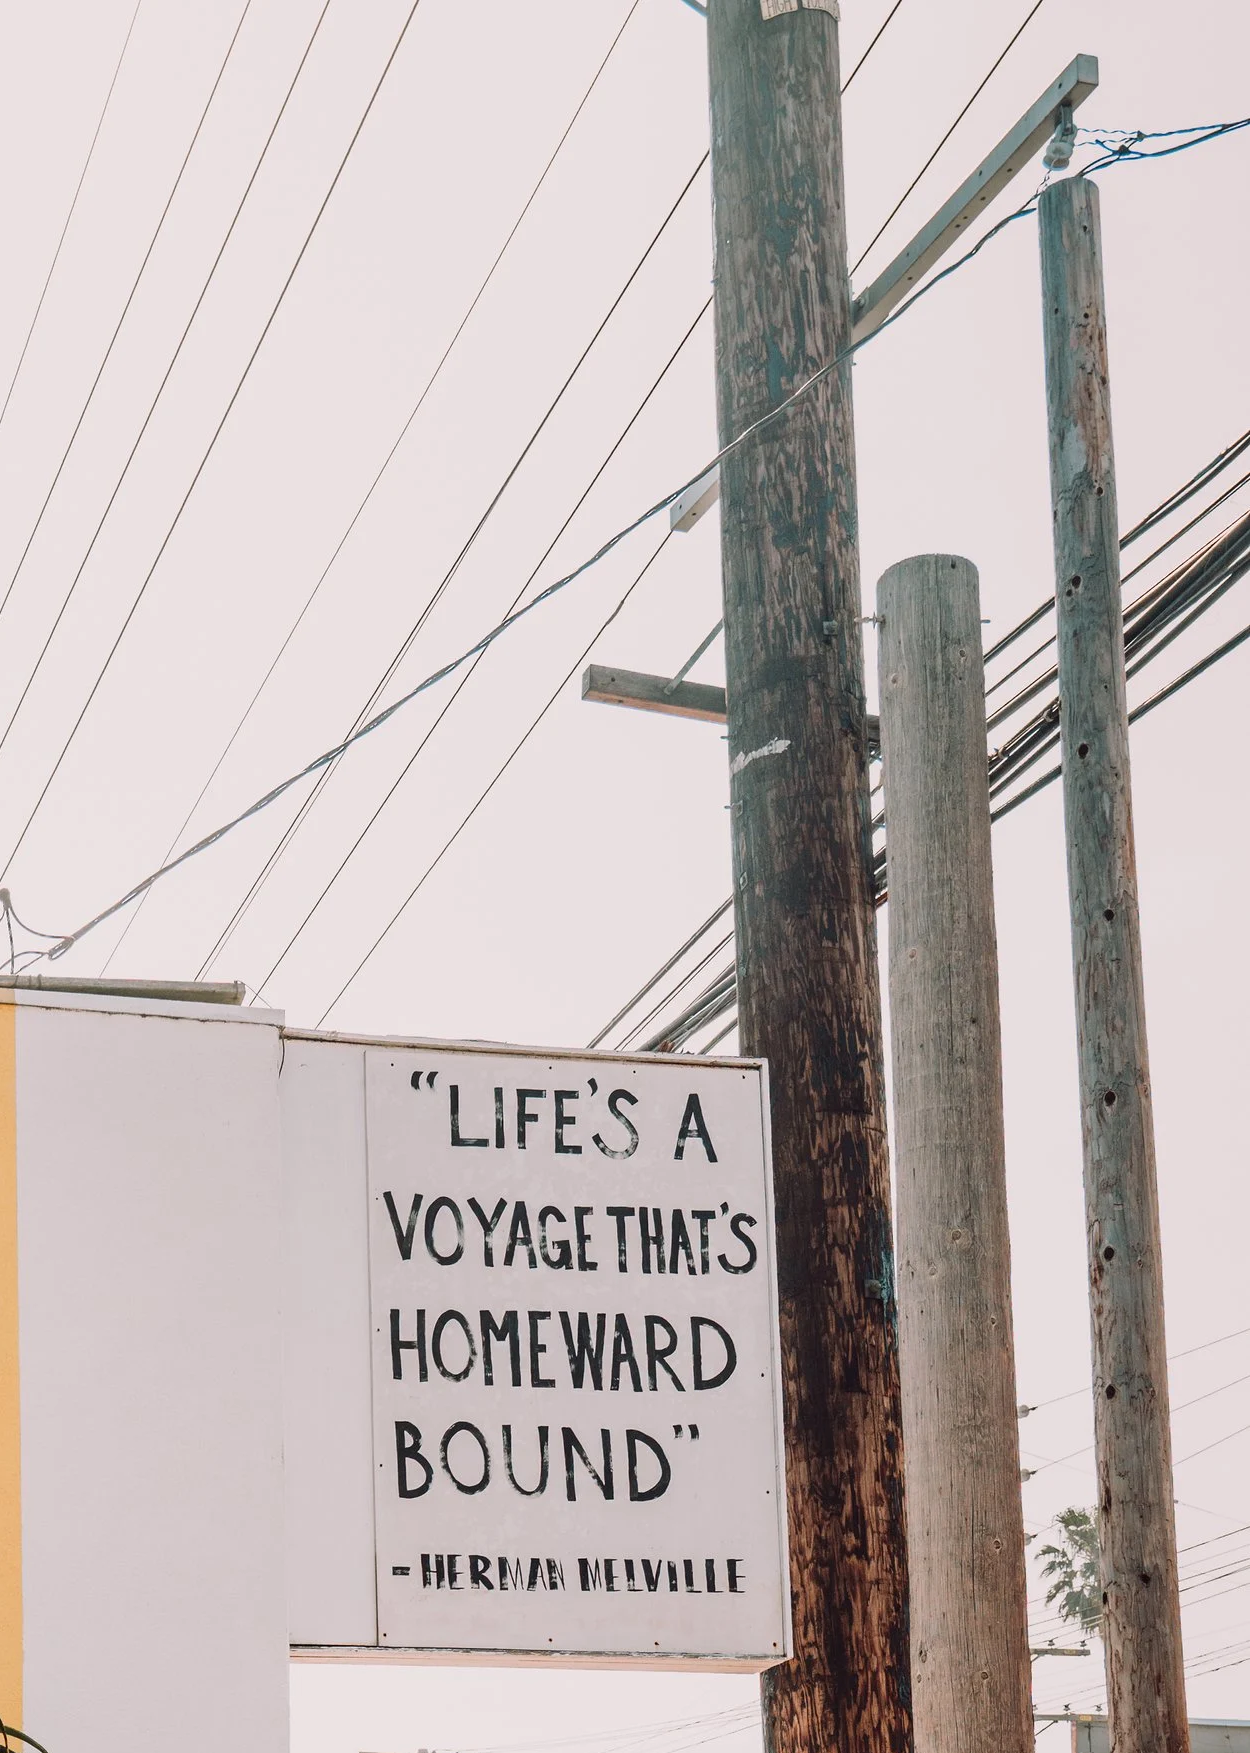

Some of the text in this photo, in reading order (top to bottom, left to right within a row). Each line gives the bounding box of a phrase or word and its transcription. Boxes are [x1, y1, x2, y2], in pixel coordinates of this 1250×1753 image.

[673, 1093, 718, 1163] A
[382, 1190, 758, 1276] VOYAGE THAT'S
[389, 1308, 738, 1392] HOMEWARD
[578, 1557, 746, 1593] MELVILLE
